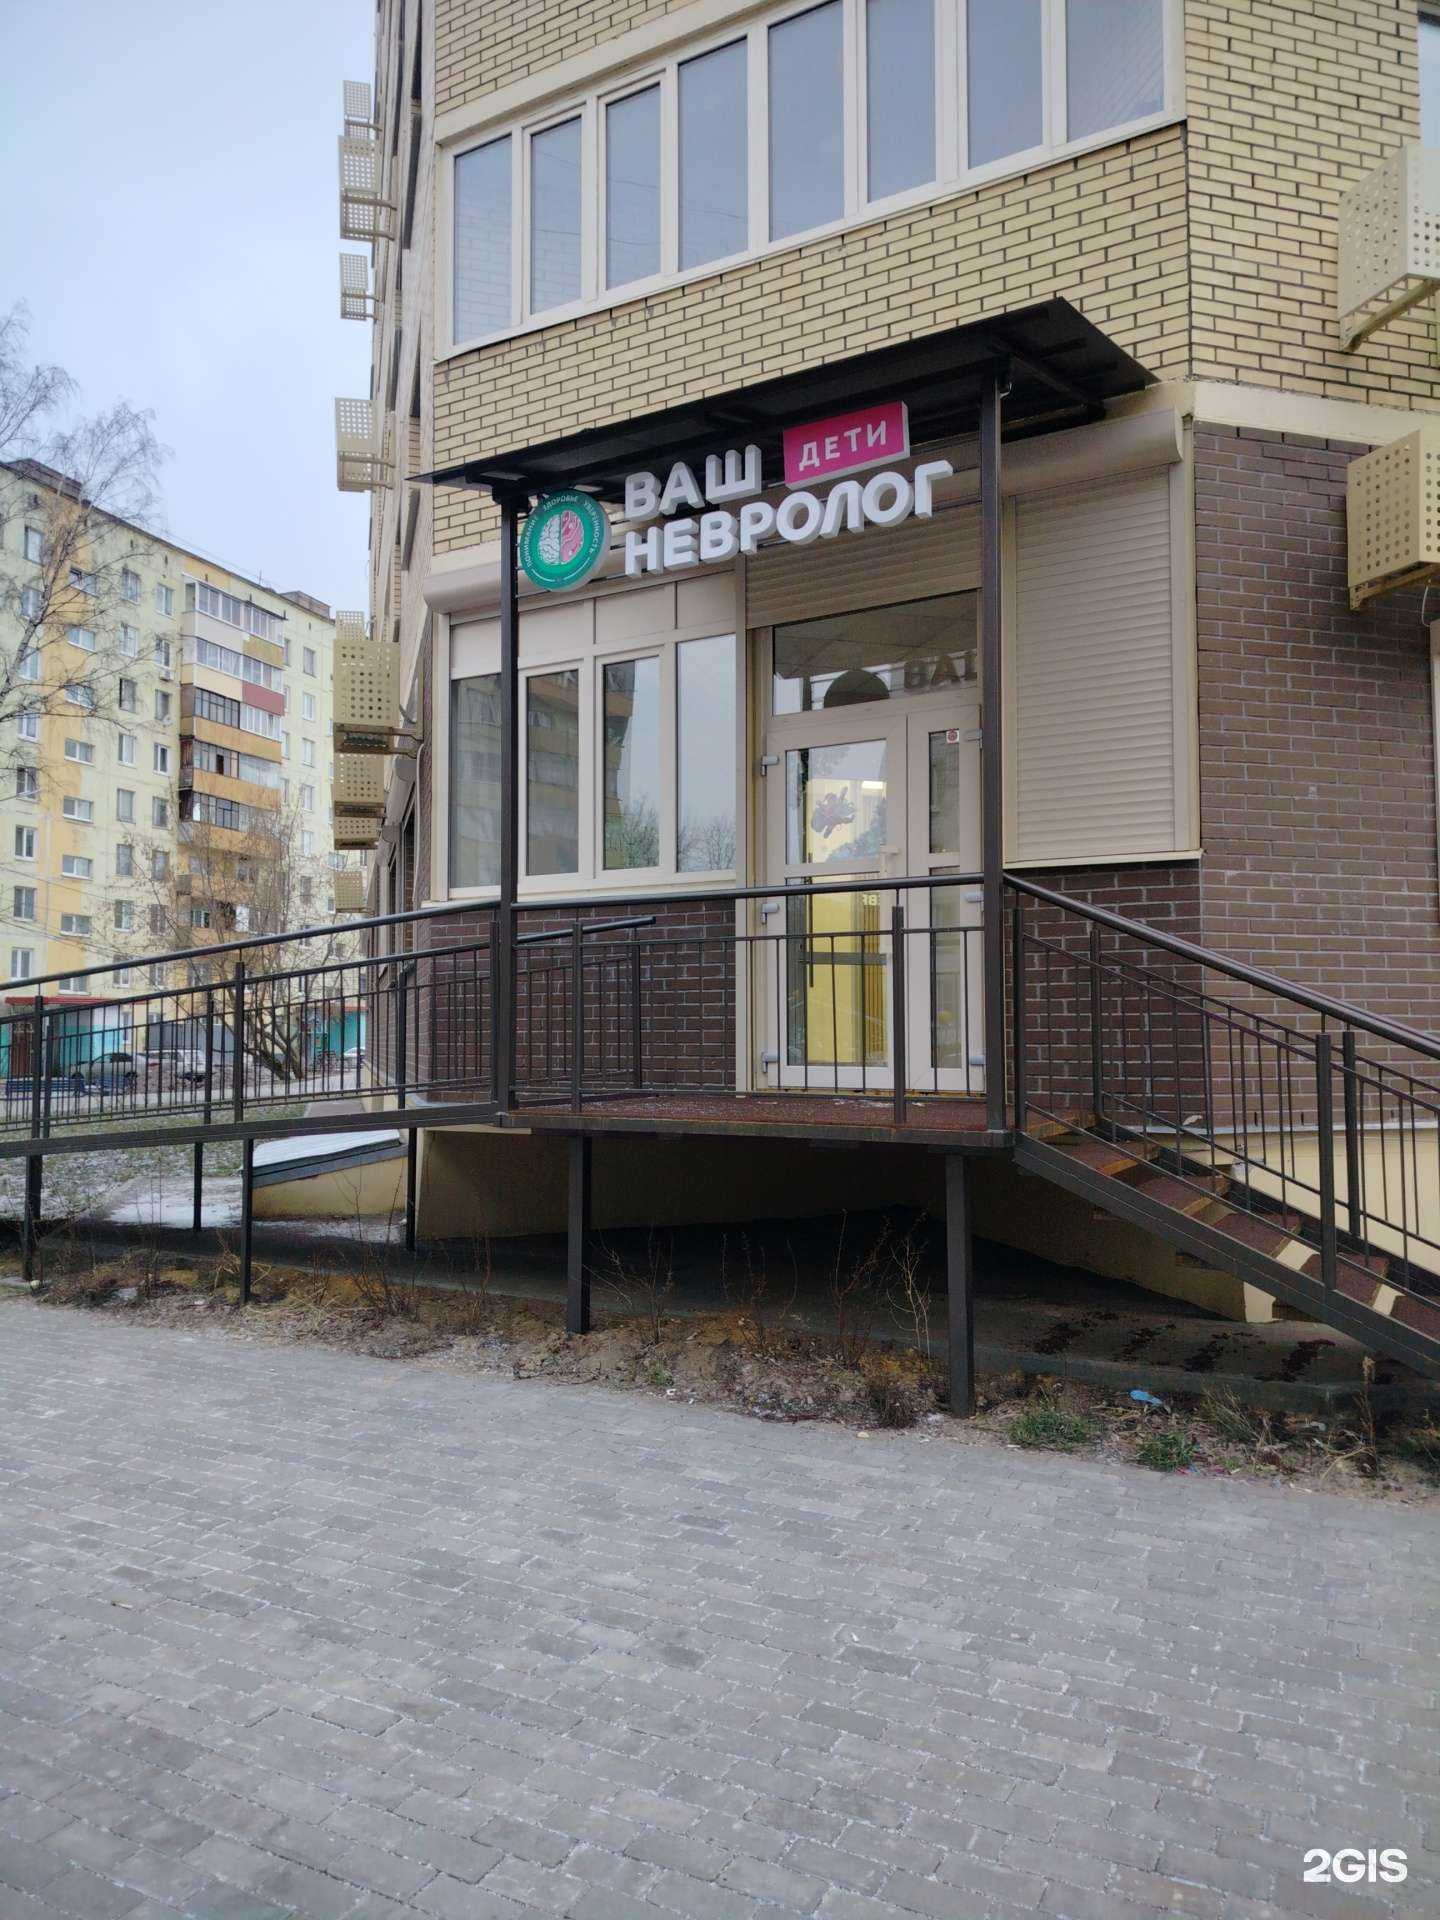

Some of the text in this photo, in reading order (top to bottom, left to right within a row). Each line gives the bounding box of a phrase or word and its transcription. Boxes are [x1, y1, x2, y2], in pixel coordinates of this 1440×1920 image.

[624, 444, 762, 523] ВАШ
[798, 420, 888, 471] ДЕТИ
[624, 459, 954, 577] НЕВРОЛОГ
